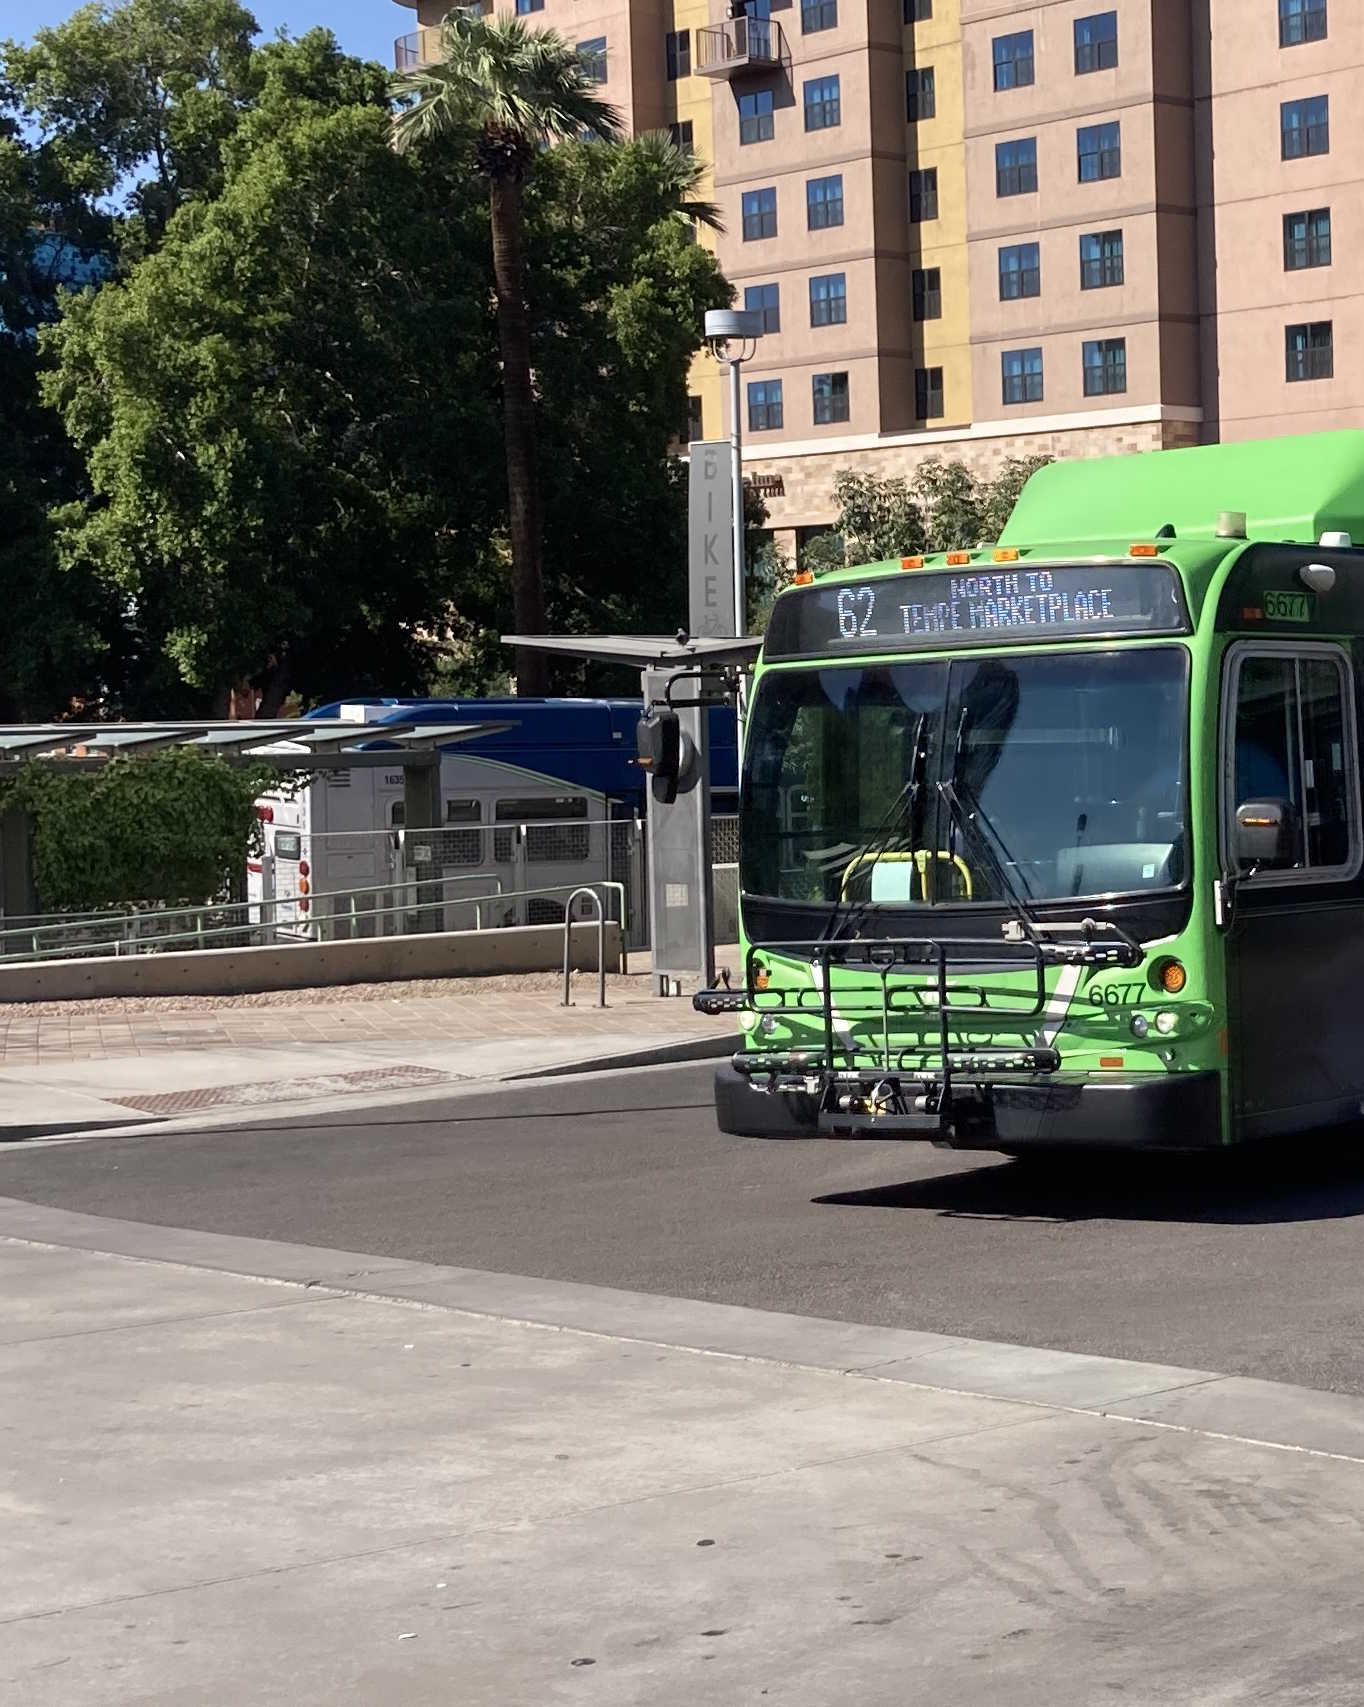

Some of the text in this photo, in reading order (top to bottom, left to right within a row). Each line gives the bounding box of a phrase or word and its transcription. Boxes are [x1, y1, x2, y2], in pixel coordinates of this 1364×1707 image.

[950, 571, 1054, 599] NORTH TO
[837, 586, 878, 638] 62
[900, 588, 1115, 634] TEMPE MARKETPLACE
[1264, 592, 1305, 617] 6677
[1089, 982, 1147, 1006] 6677
